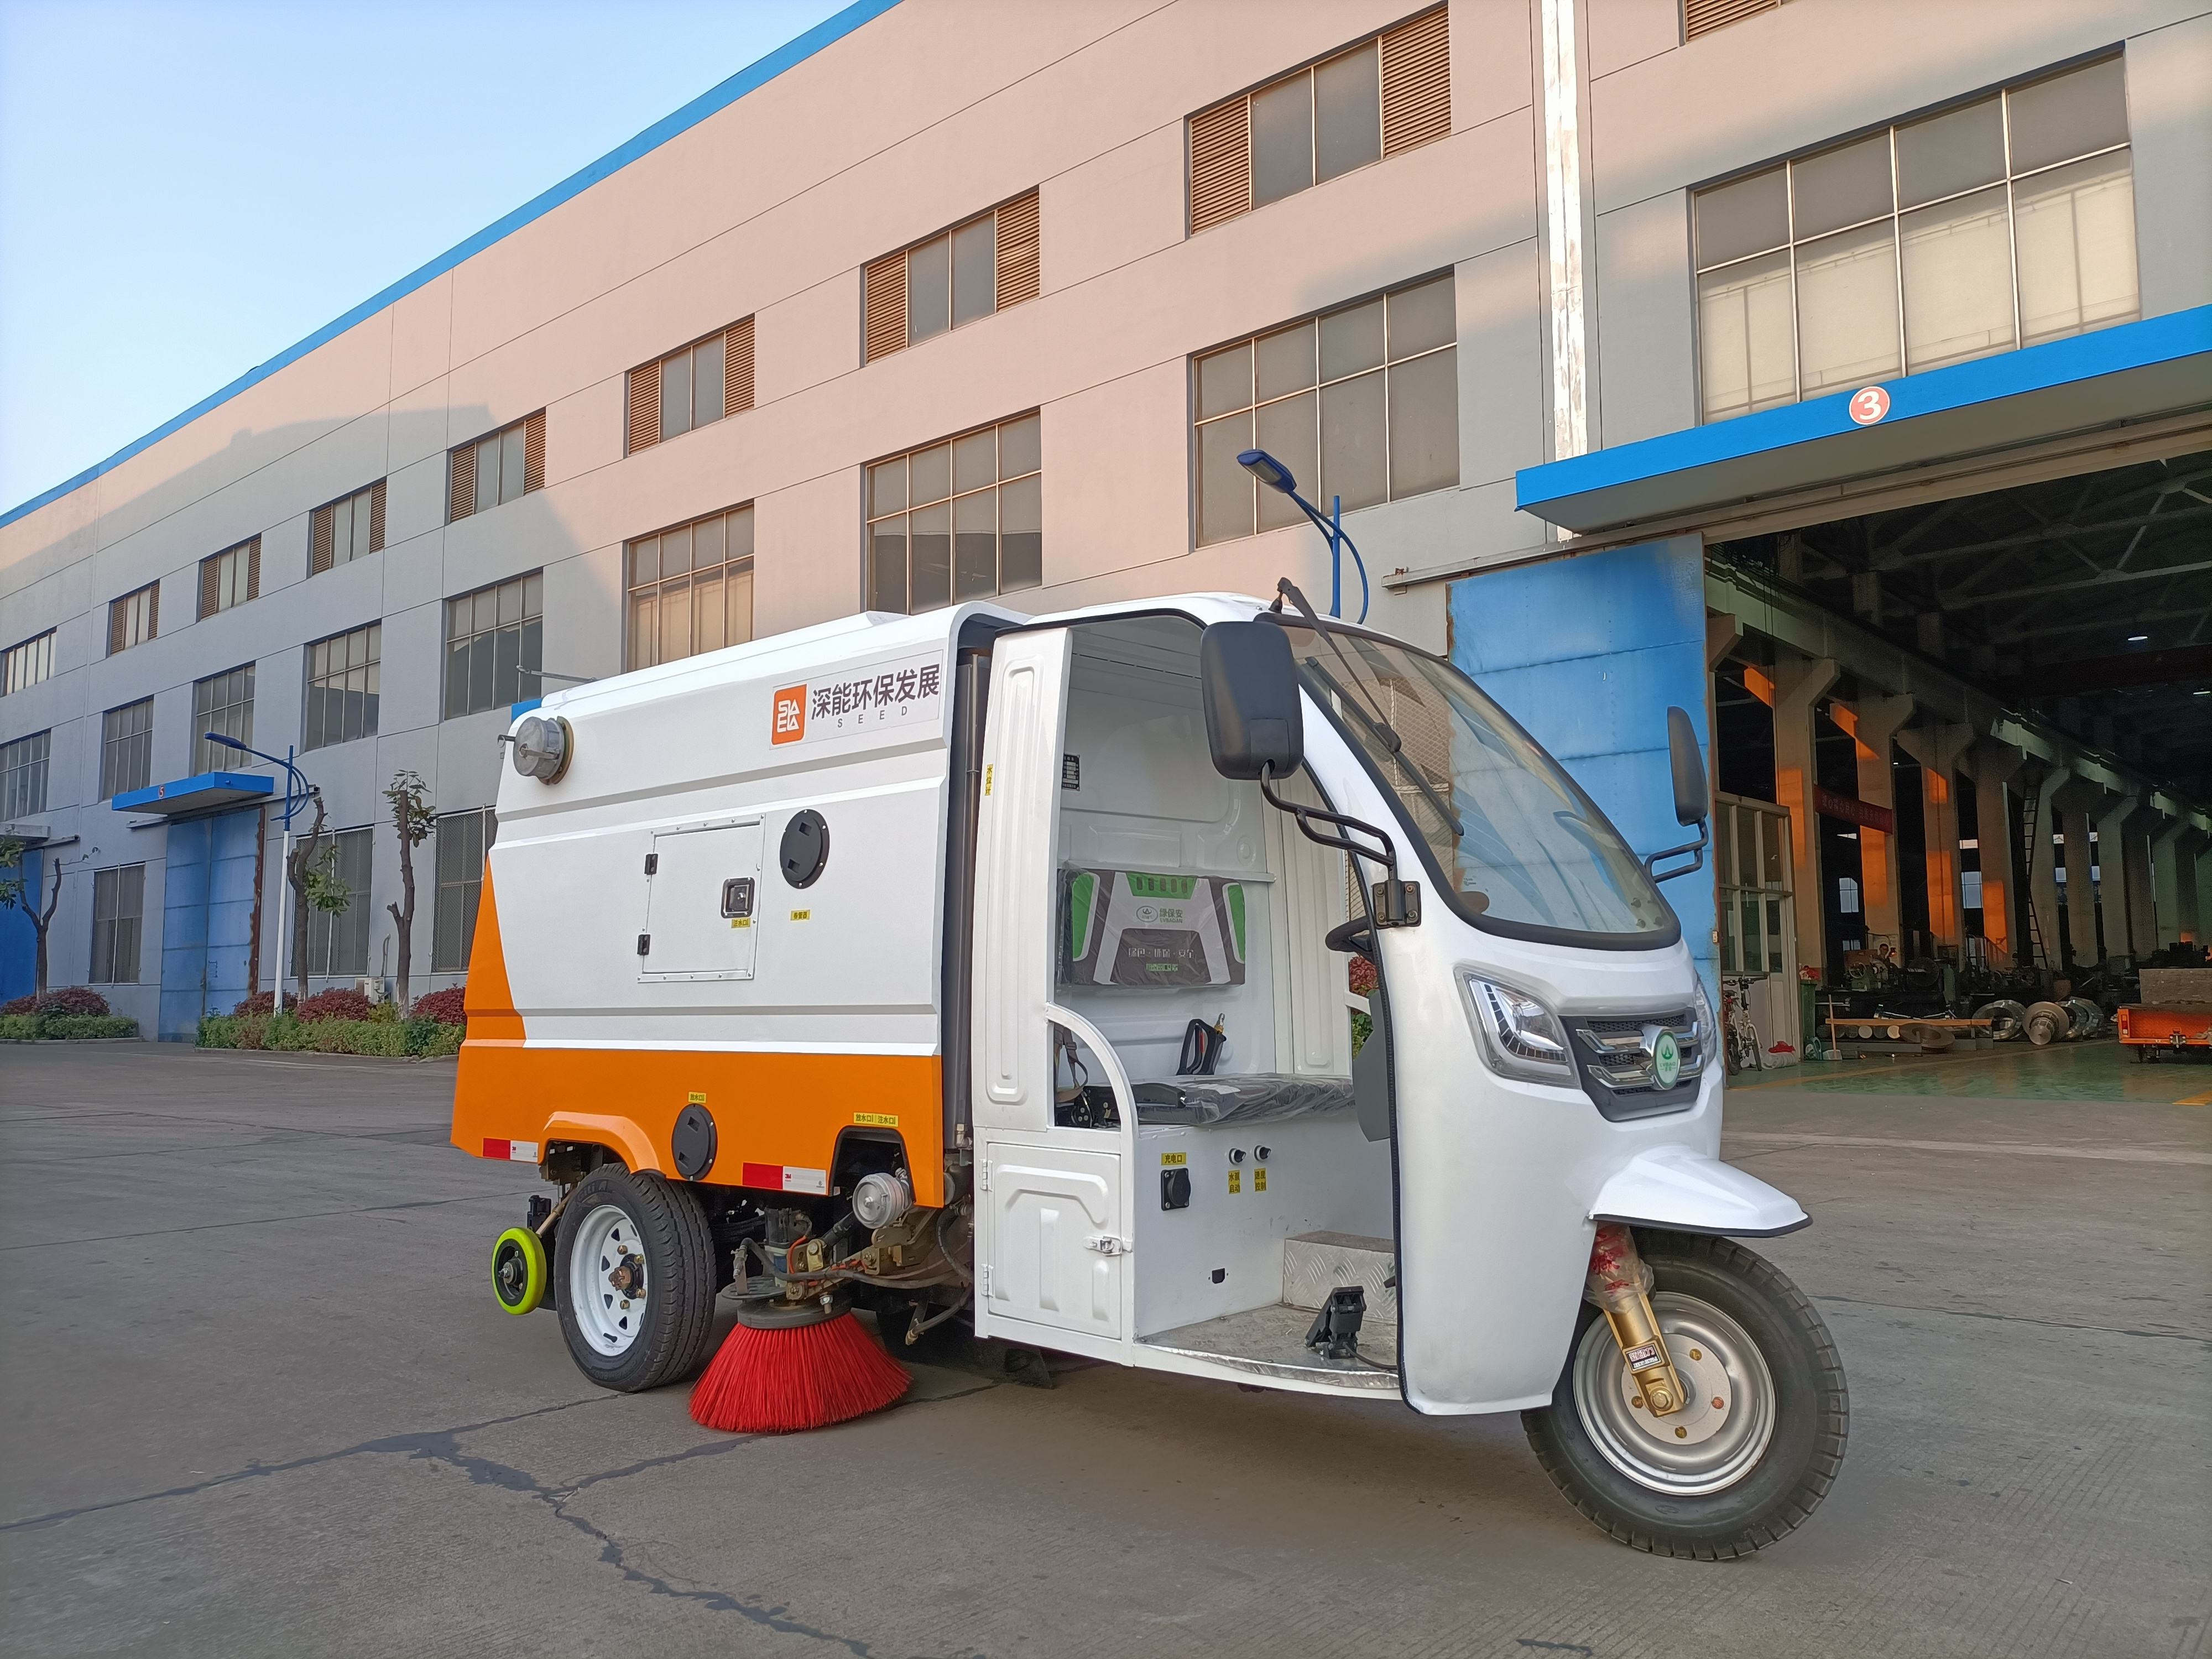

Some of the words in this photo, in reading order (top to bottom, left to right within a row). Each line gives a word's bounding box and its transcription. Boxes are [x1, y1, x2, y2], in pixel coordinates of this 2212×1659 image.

[1858, 391, 1881, 420] 3
[811, 664, 940, 720] 深能环保发展
[837, 706, 907, 728] SEED
[1165, 1154, 1182, 1164] 充电口
